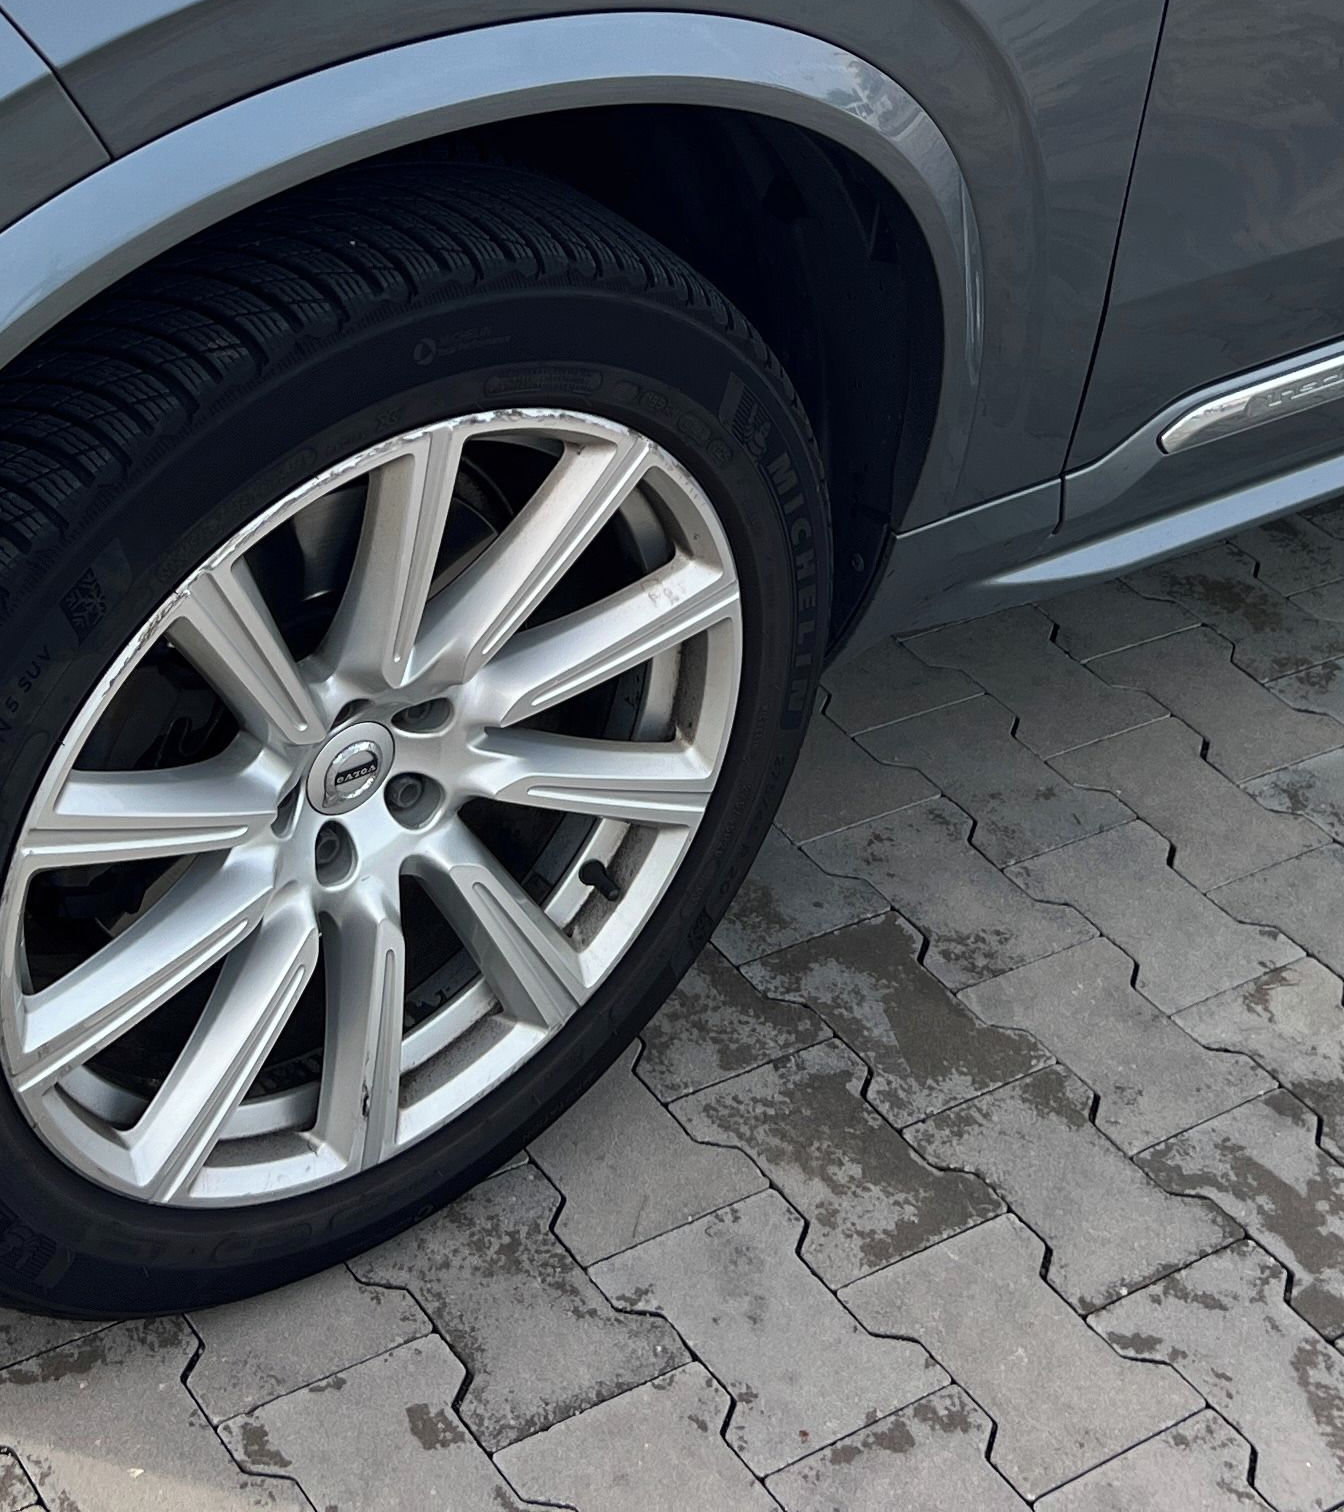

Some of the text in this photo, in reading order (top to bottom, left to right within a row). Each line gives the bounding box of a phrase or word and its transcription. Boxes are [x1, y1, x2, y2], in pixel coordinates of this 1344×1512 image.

[764, 450, 819, 713] MICHELIN
[7, 694, 20, 714] 5
[17, 643, 54, 694] SUV
[336, 764, 377, 785] VOLVO
